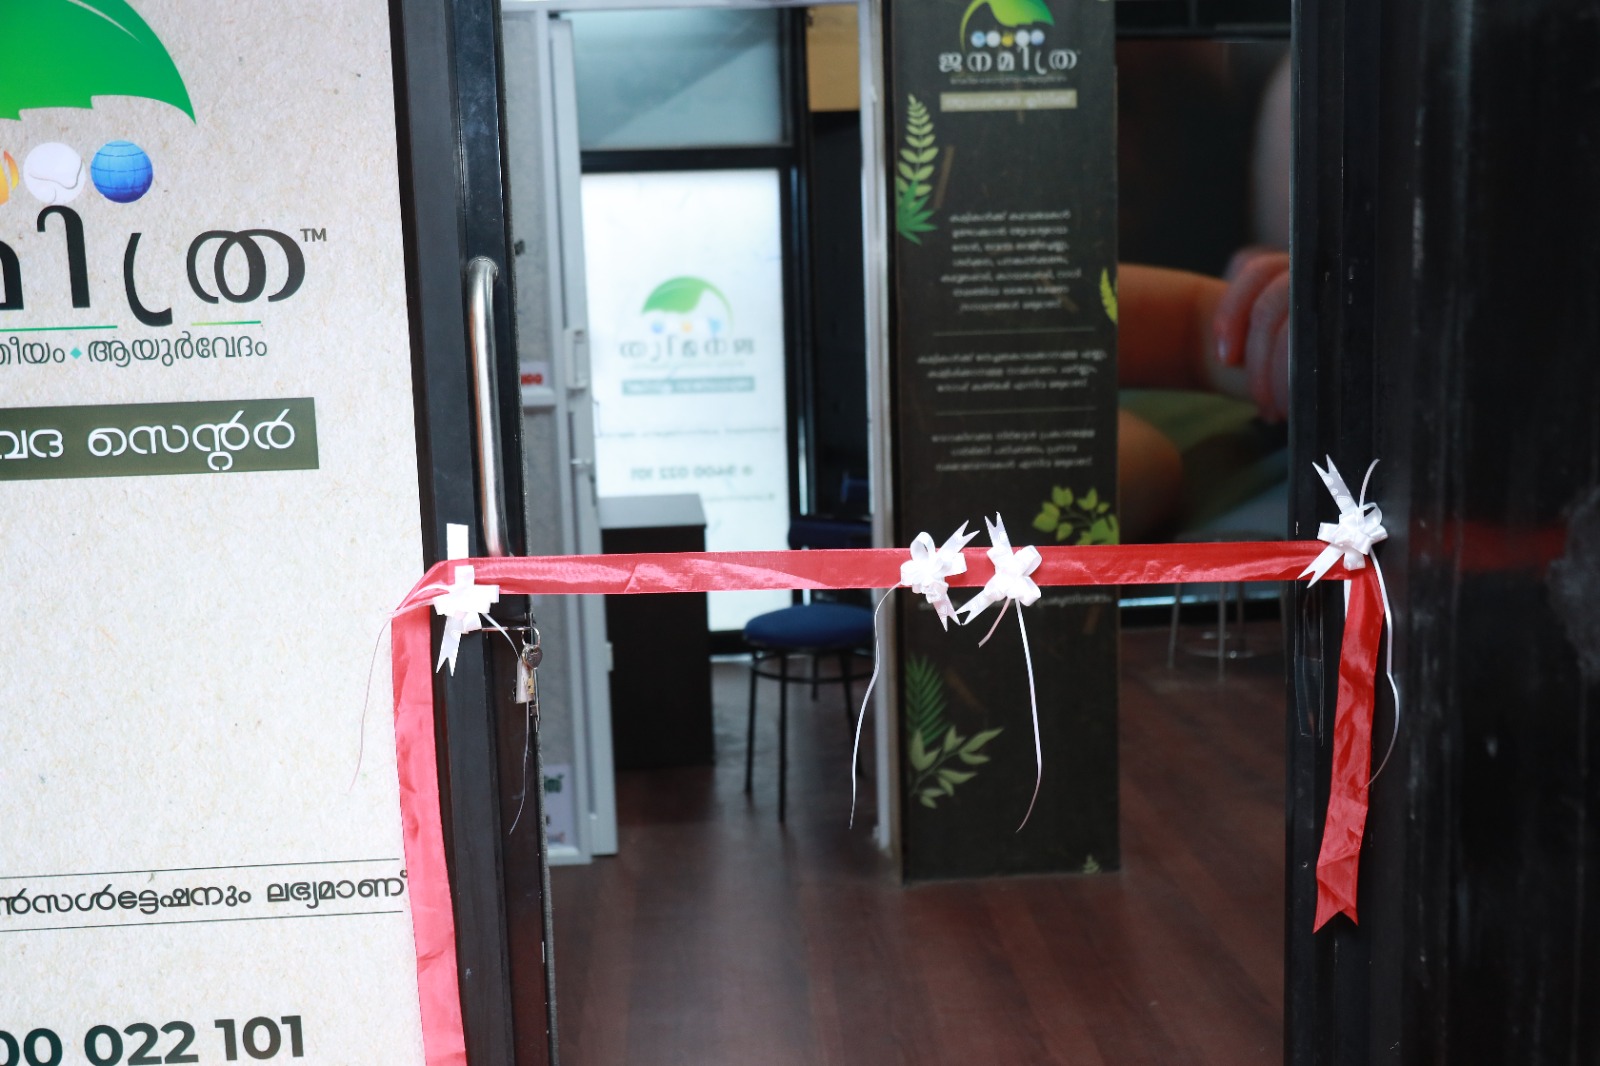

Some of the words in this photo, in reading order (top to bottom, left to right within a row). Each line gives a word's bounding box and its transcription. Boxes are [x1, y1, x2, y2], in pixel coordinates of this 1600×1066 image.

[0, 204, 306, 327] ിത്ര
[87, 330, 268, 368] ആയുർവേദം
[84, 1020, 199, 1066] 022
[214, 1014, 304, 1061] 101
